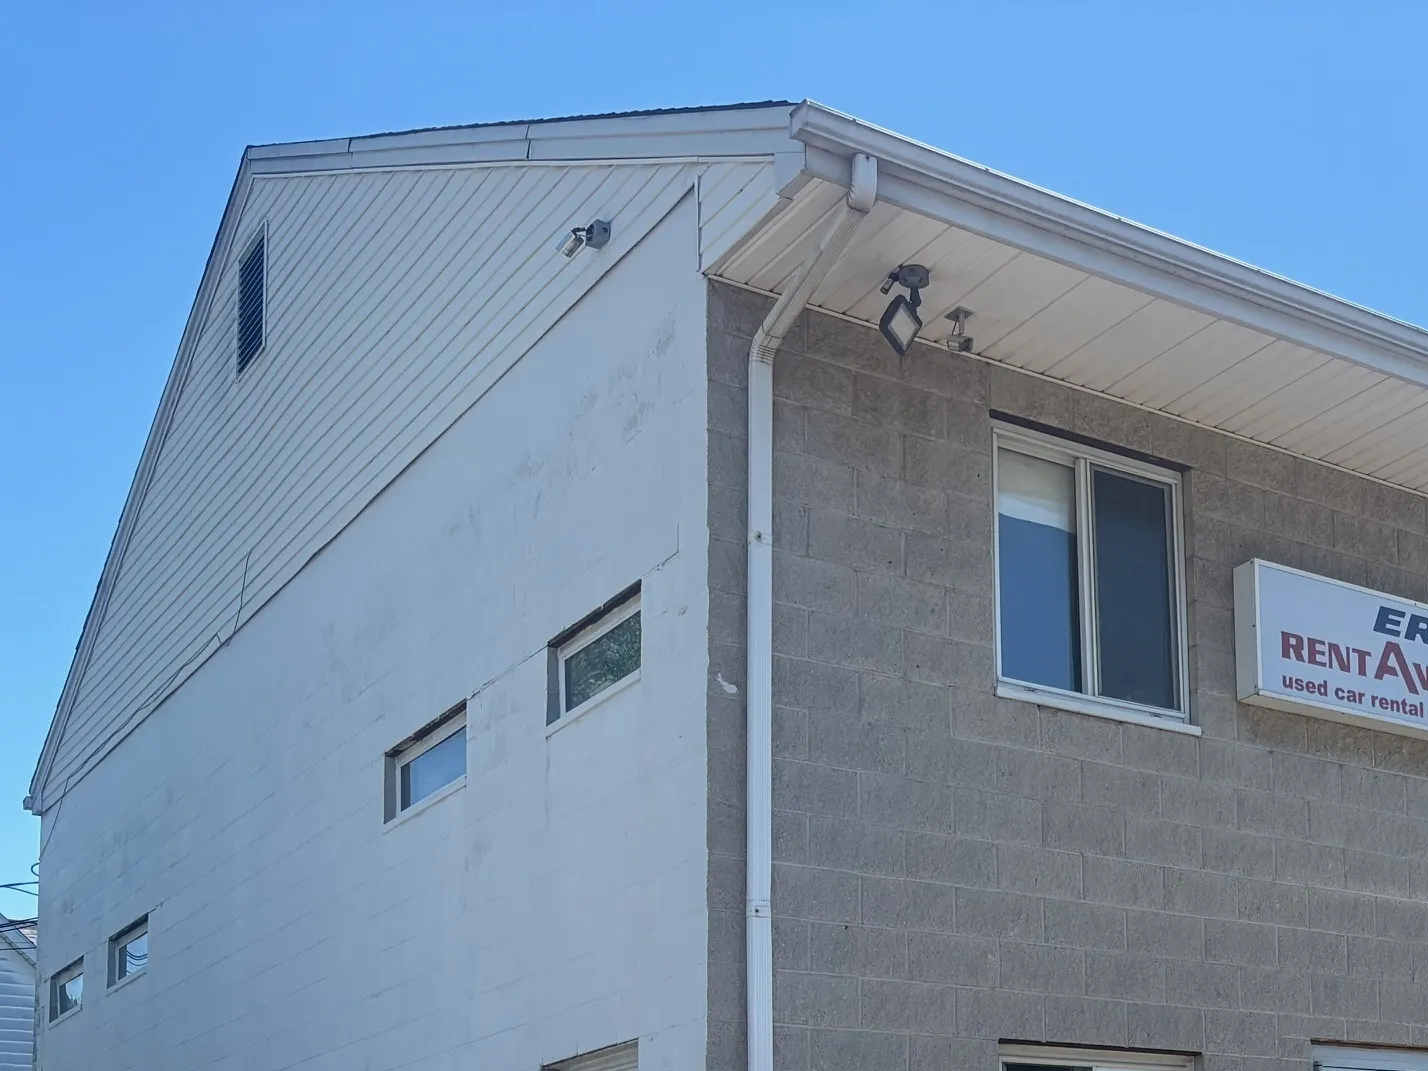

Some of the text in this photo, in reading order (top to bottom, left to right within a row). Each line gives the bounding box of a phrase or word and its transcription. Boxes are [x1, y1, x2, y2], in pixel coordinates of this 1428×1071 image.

[1282, 675, 1328, 697] used
[1334, 687, 1366, 706] car
[1371, 693, 1425, 719] rental
